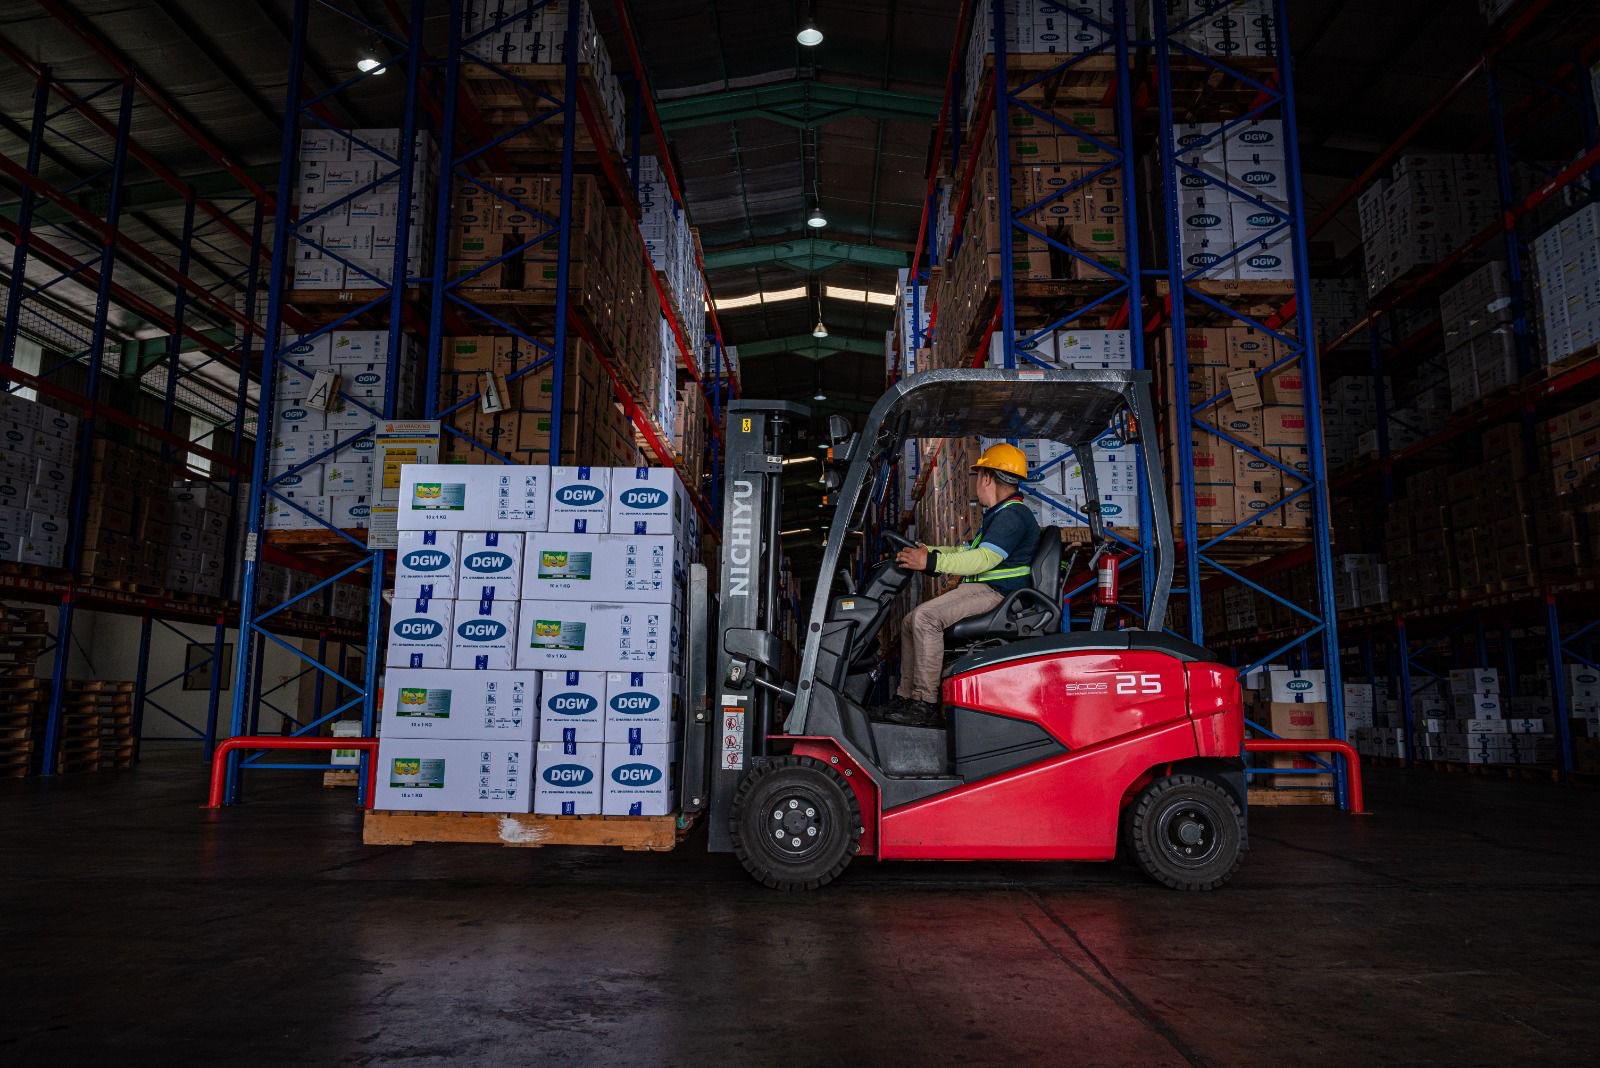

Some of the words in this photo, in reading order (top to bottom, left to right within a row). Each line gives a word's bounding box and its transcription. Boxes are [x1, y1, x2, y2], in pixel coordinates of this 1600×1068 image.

[1244, 133, 1269, 141] DGW
[1247, 174, 1271, 182] DGW
[1192, 217, 1216, 225] DGW
[1251, 216, 1276, 224] DGW
[1252, 258, 1277, 266] DGW
[358, 375, 378, 383] DGW
[308, 382, 328, 405] A
[284, 410, 304, 418] DGW
[563, 489, 596, 501] DGW
[627, 492, 660, 504] DGW
[730, 480, 753, 597] NICHIYU
[409, 555, 443, 566] DGW
[471, 556, 505, 568] DGW
[401, 623, 435, 635] DGW
[465, 624, 498, 636] DGW
[1115, 674, 1162, 695] 25
[555, 697, 589, 710] DGW
[618, 697, 651, 709] DGW
[551, 769, 585, 781] DGW
[620, 769, 653, 781] DGW
